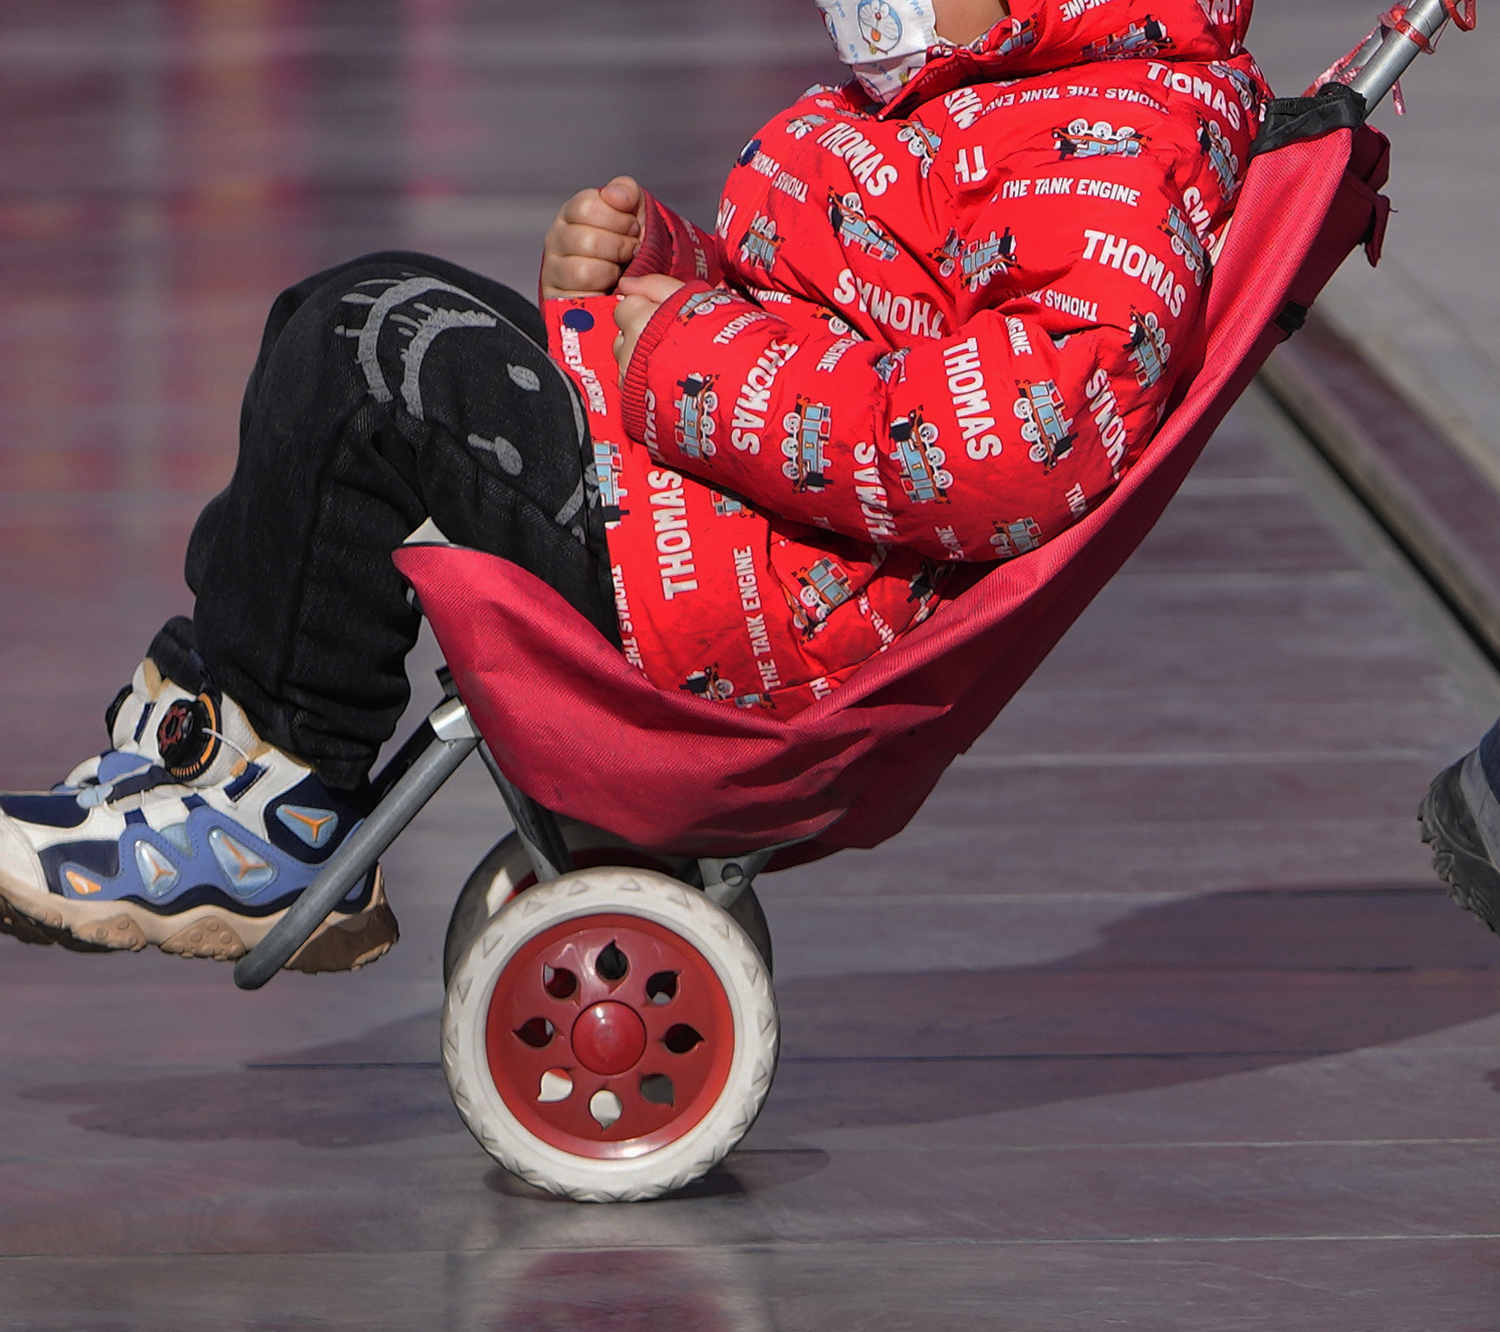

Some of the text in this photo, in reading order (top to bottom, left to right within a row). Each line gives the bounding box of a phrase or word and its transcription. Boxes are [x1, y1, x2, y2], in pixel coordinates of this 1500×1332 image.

[1019, 87, 1060, 105] TANK
[1065, 84, 1100, 99] THE
[815, 121, 899, 197] THOMAS
[1002, 177, 1143, 208] THE TANK ENGINE
[834, 267, 946, 341] THOMAS
[1044, 288, 1099, 323] THOMAS
[1082, 228, 1187, 319] THOMAS
[942, 336, 1004, 462] THOMAS
[647, 469, 699, 601] THOMAS
[732, 545, 782, 691] THE TANK ENGINE
